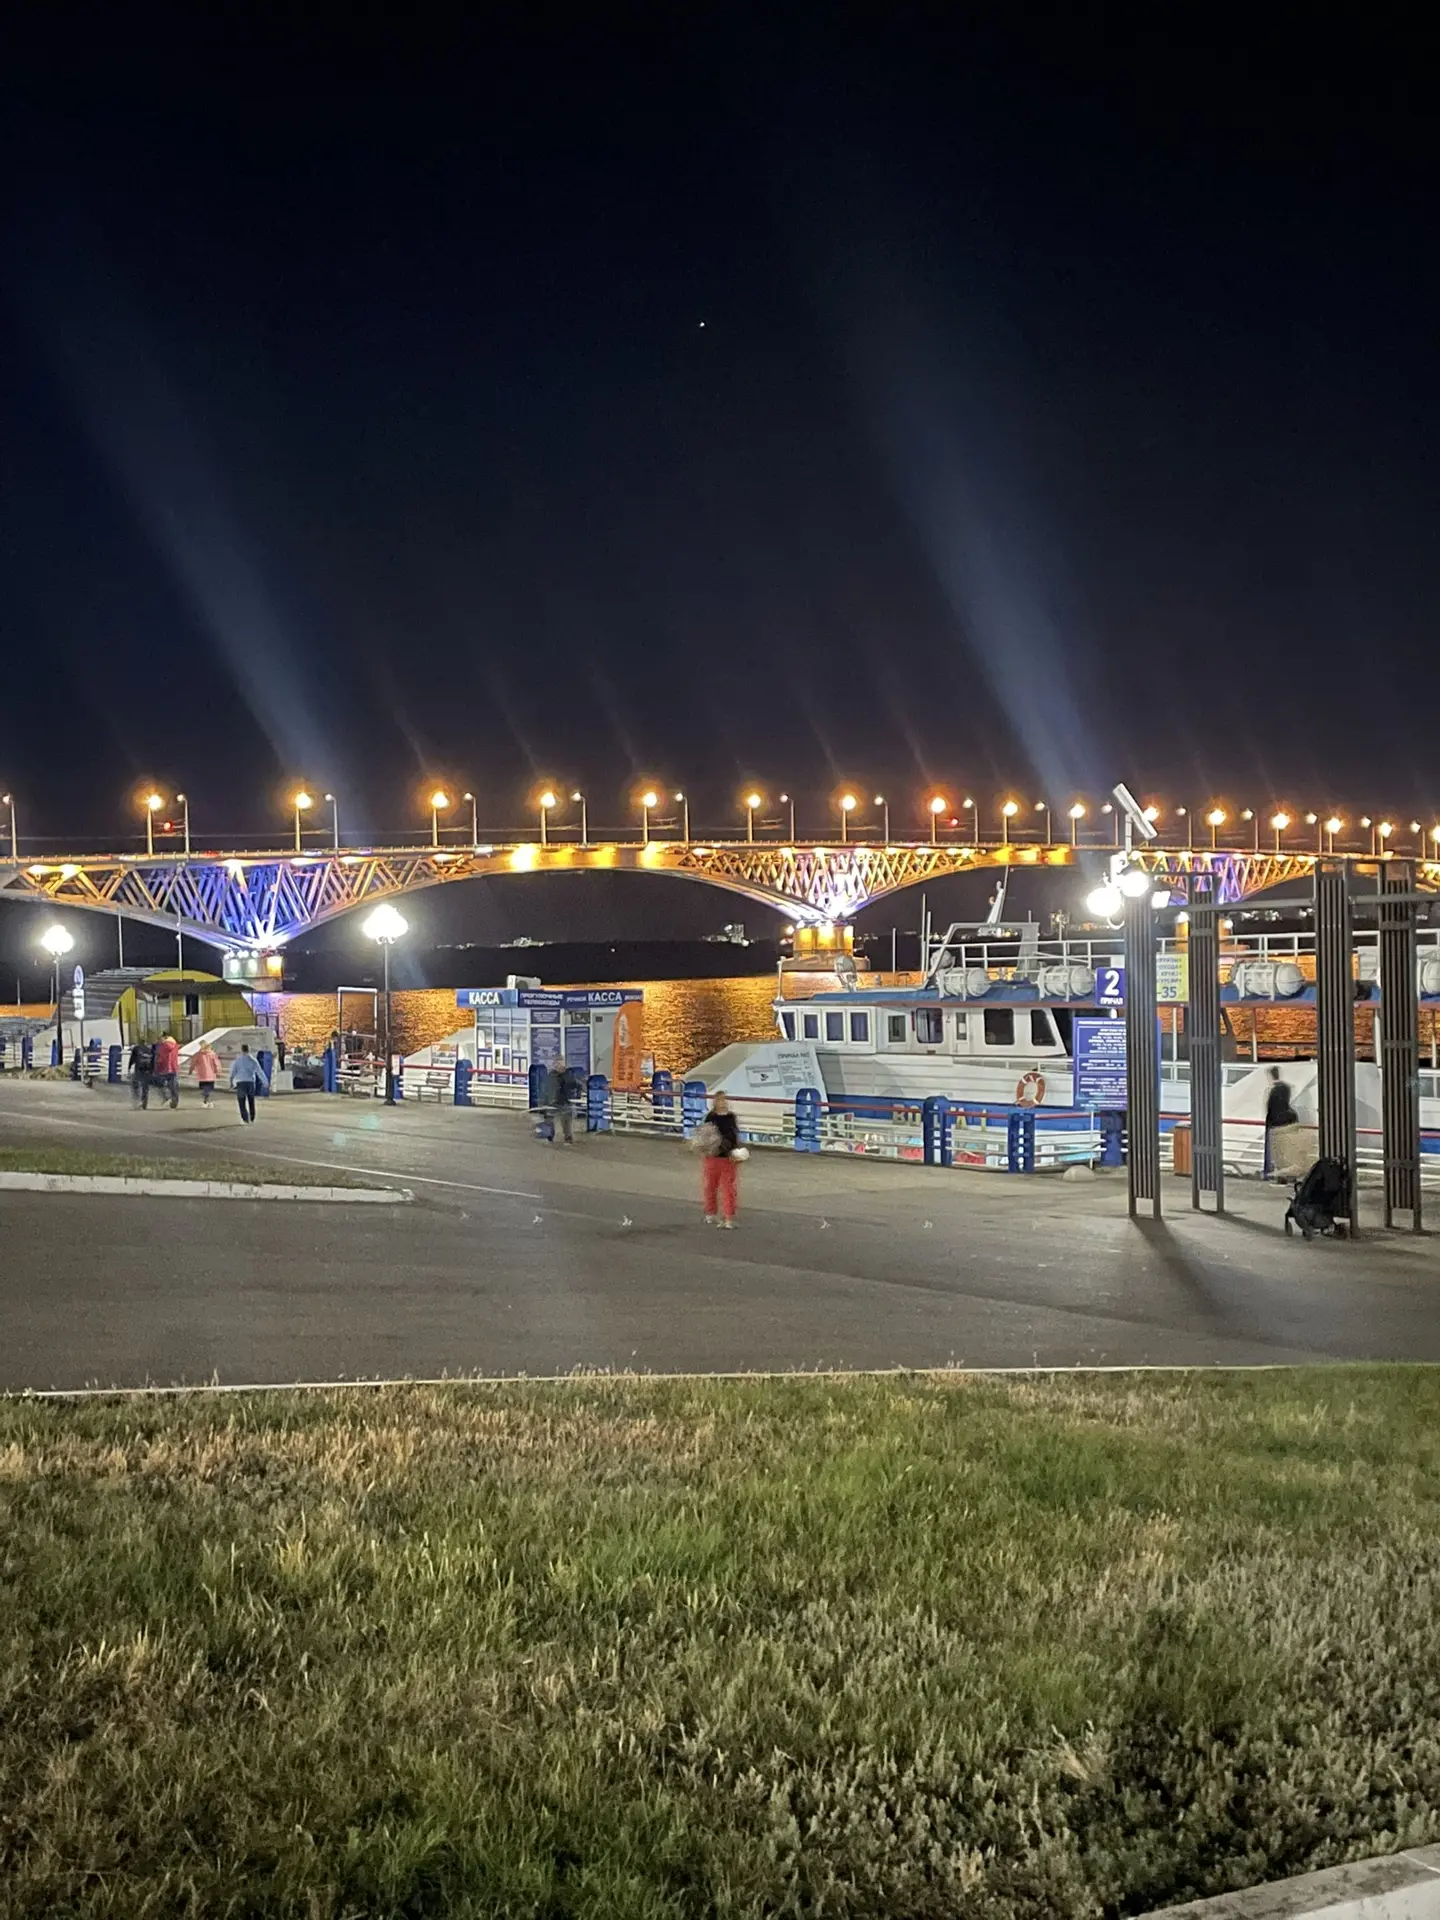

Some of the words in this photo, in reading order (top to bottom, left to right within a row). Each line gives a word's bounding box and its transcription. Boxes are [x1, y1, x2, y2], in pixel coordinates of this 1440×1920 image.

[1104, 970, 1120, 996] 2
[469, 991, 500, 1005] КАССА
[587, 992, 622, 1002] КАССА
[1100, 997, 1123, 1005] ПРИЧАЛ
